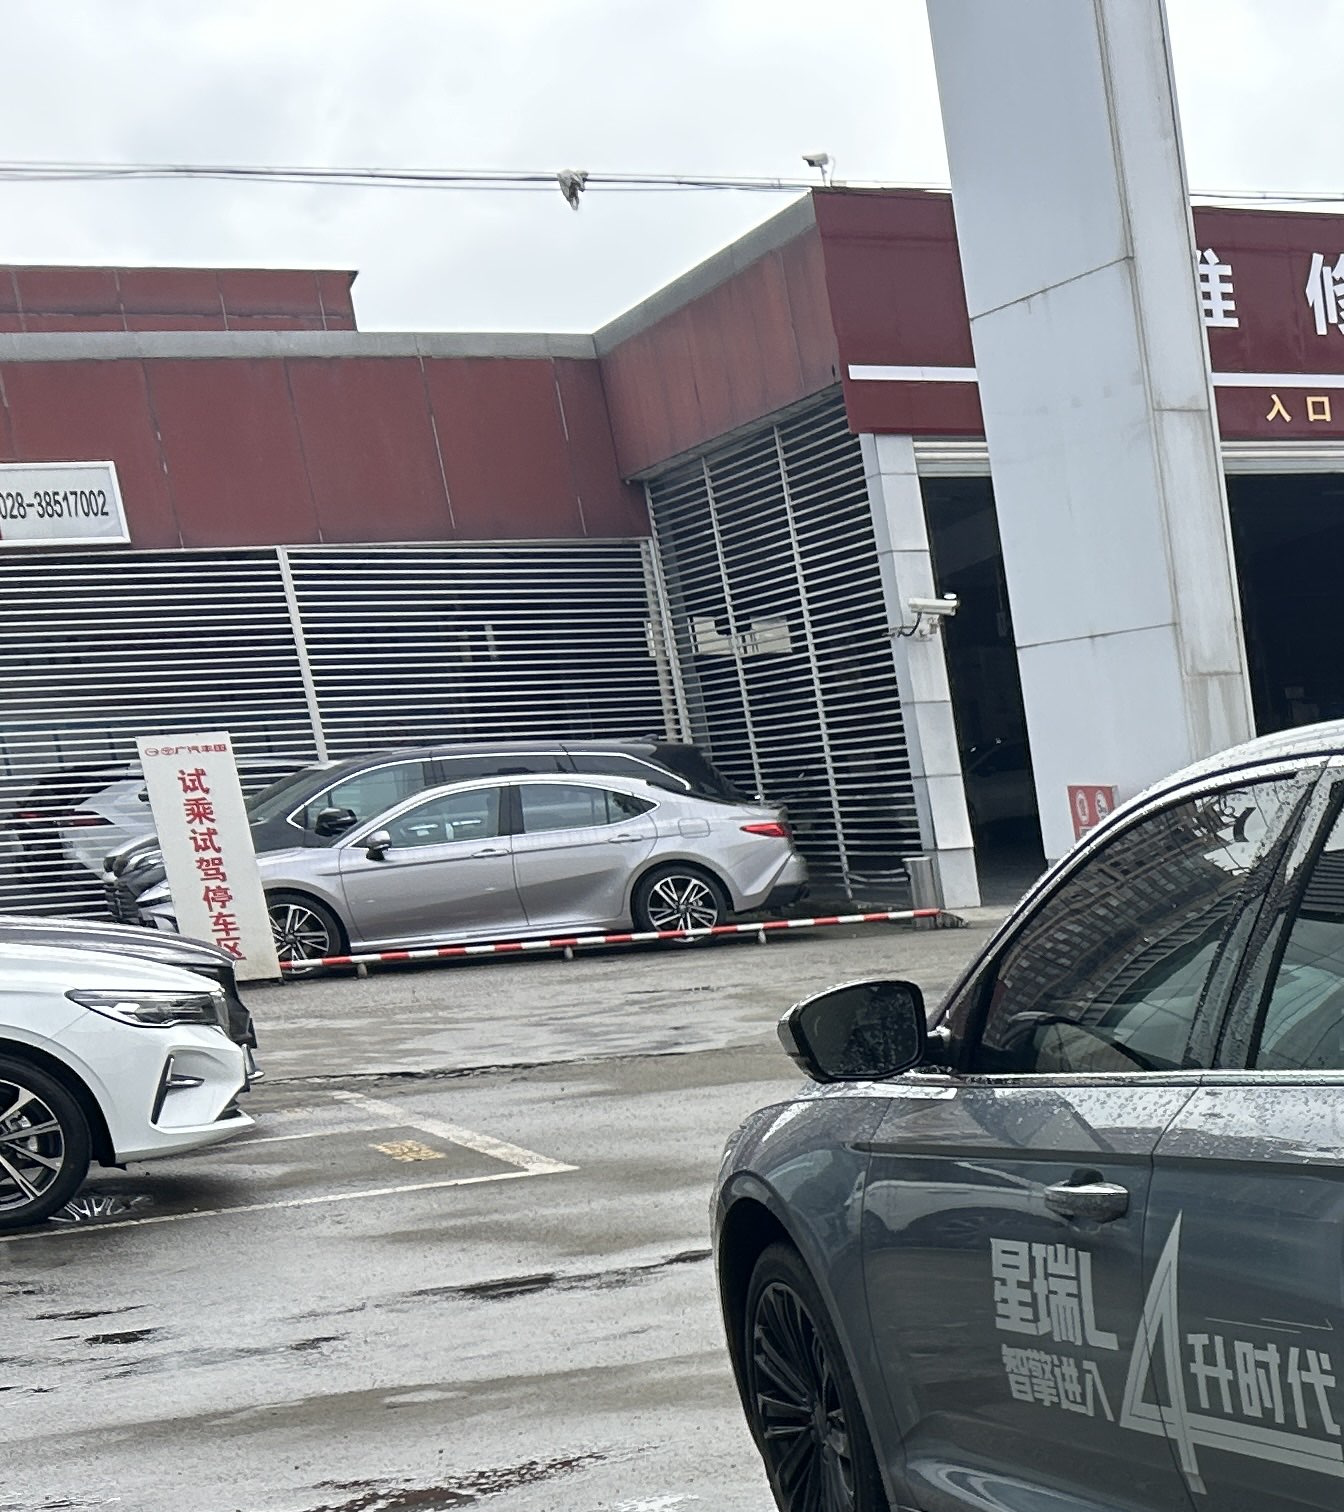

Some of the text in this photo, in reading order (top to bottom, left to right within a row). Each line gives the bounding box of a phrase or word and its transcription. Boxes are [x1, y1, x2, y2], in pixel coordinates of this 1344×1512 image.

[1266, 393, 1332, 423] 入口
[177, 768, 247, 961] 试乘试驾停车区
[1186, 1332, 1342, 1436] 升时代
